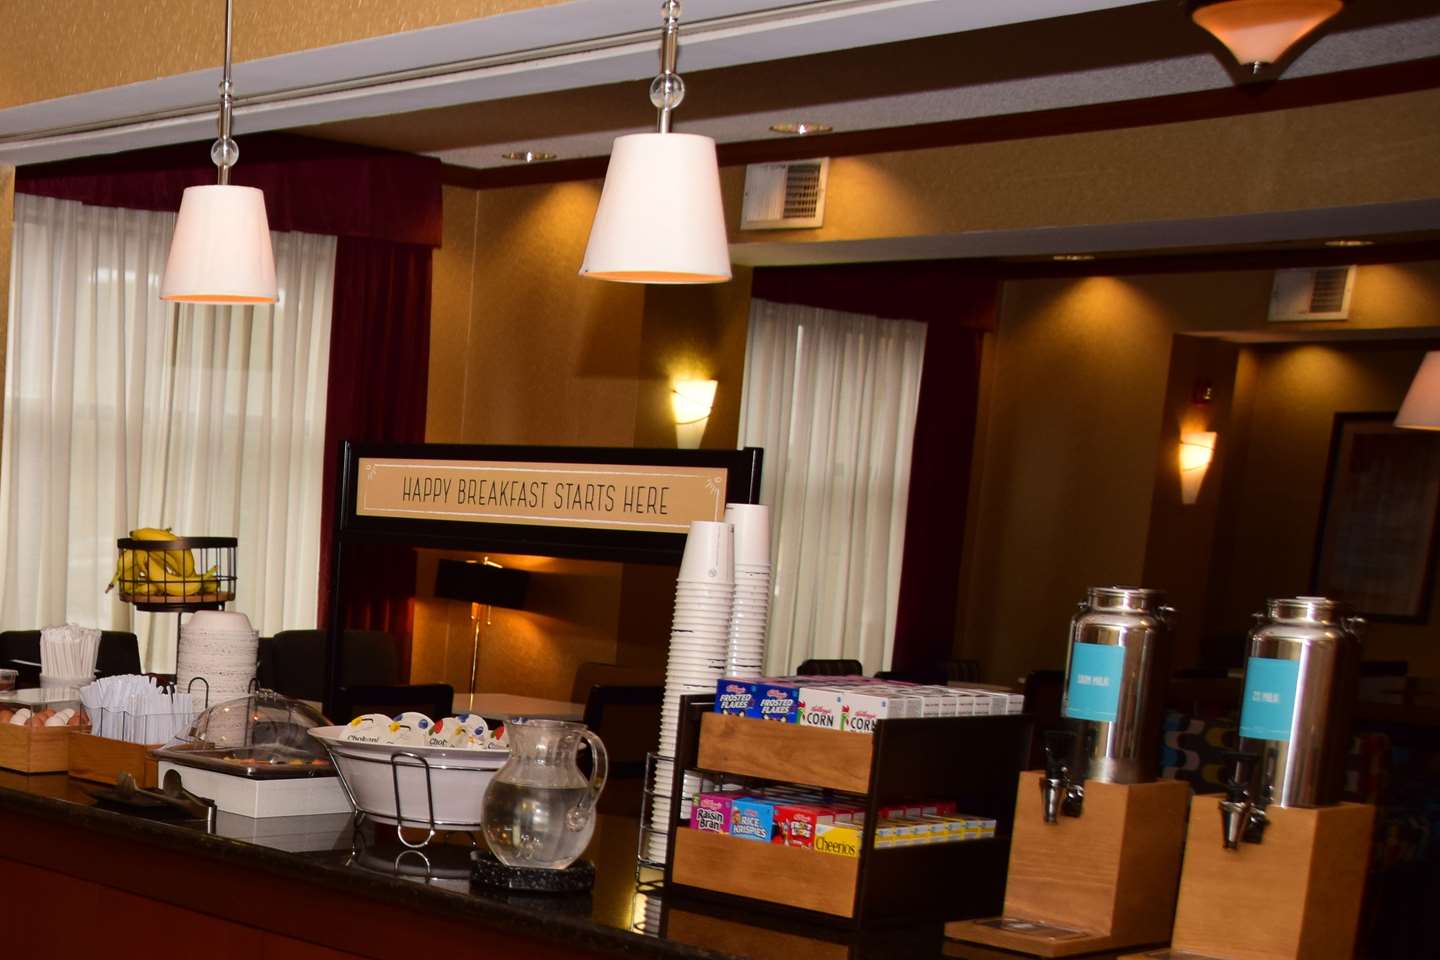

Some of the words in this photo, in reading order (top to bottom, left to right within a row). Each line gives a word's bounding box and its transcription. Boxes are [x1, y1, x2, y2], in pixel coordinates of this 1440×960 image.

[403, 476, 452, 504] HAPPY
[458, 479, 548, 508] BREAKFAST
[553, 482, 616, 512] STARTS
[623, 486, 670, 515] HERE
[720, 701, 749, 710] FLAKES
[761, 706, 790, 715] FLAKES
[807, 712, 834, 727] CORN
[697, 808, 723, 823] Raisin
[741, 815, 760, 827] RICE
[700, 818, 720, 832] Bran
[733, 825, 767, 839] KRISPIES
[816, 836, 856, 856] Cheerios
